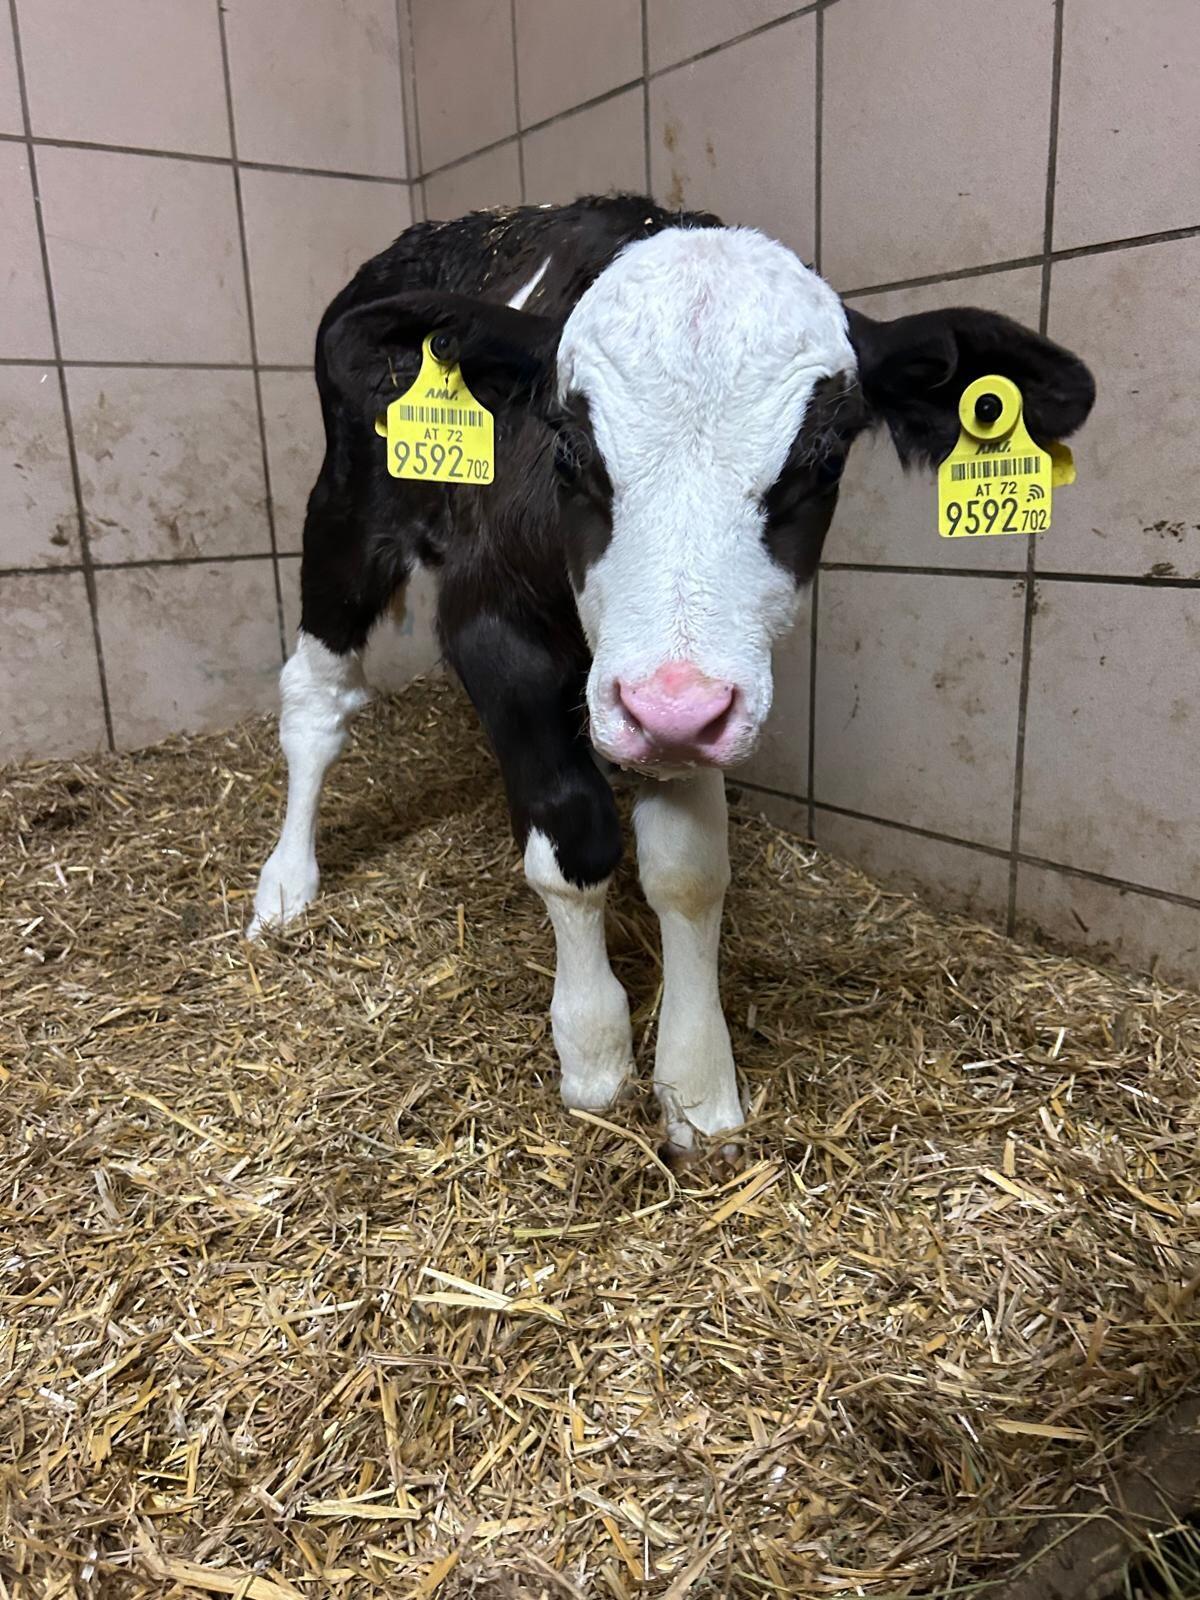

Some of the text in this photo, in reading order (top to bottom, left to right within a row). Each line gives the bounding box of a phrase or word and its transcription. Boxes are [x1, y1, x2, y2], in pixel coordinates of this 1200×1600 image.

[424, 428, 463, 442] AT 72
[394, 441, 489, 480] 9592 702
[975, 481, 1017, 497] AT 72
[946, 498, 1047, 536] 9592 702
